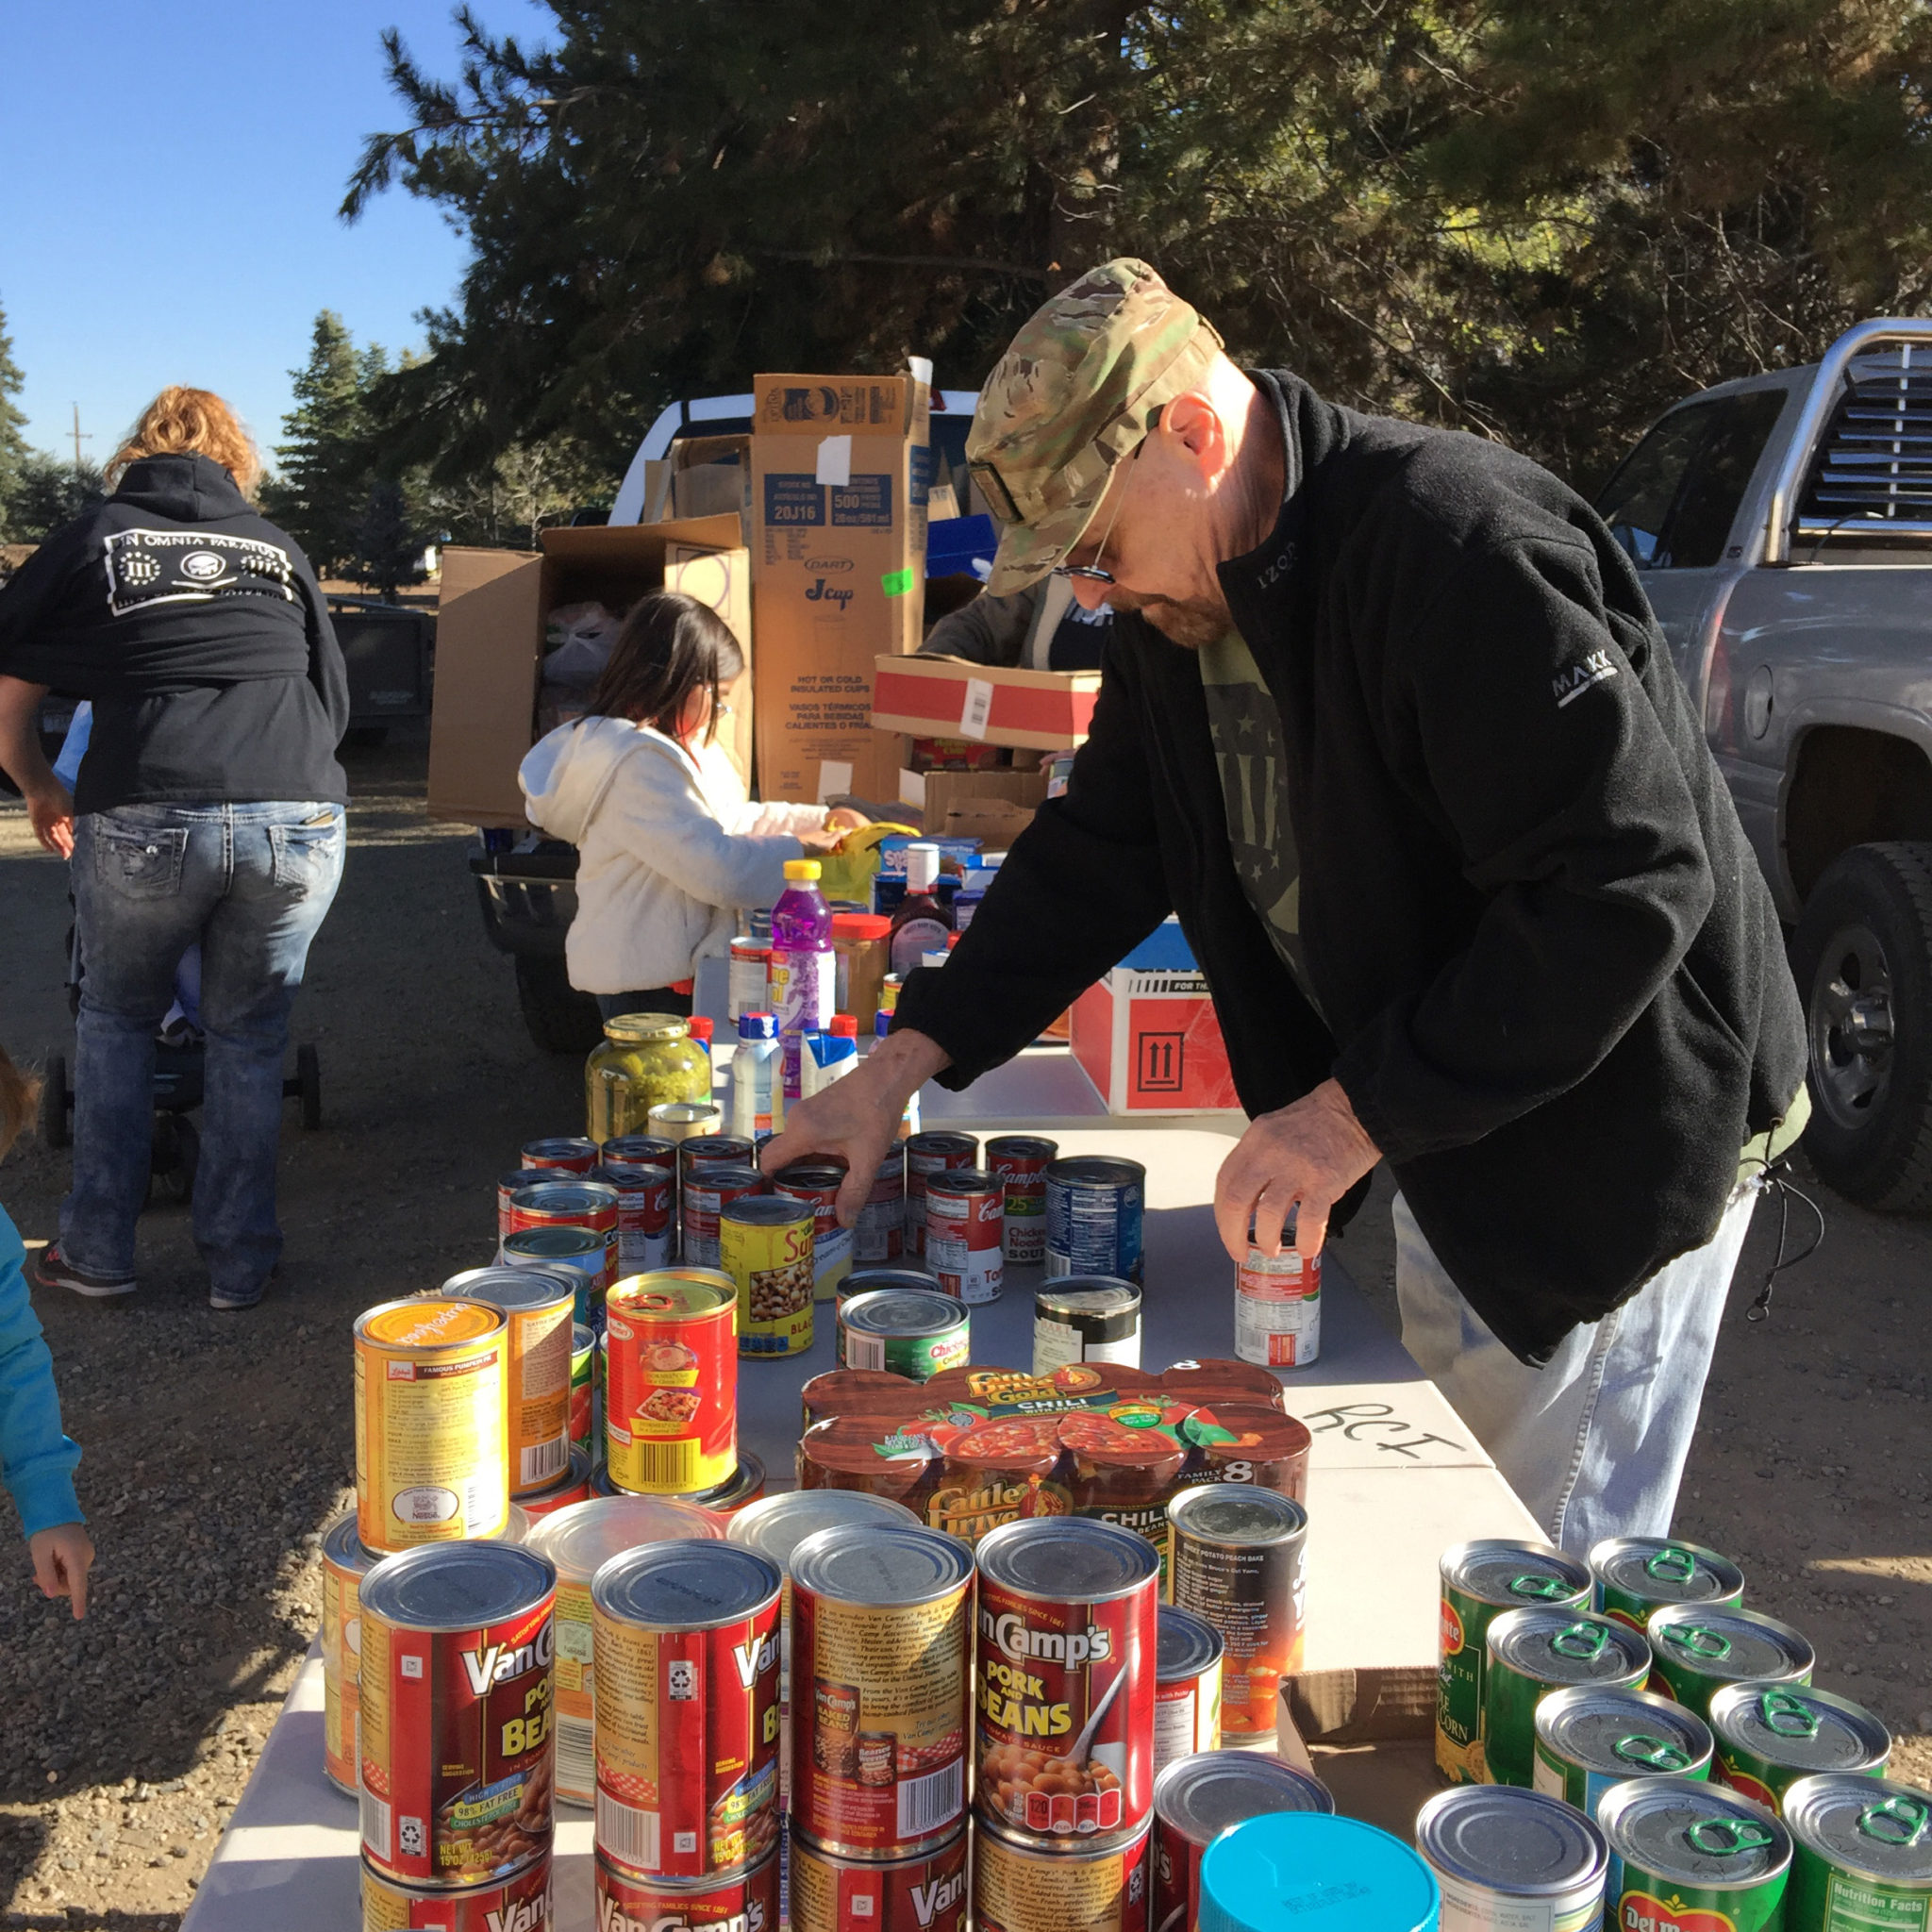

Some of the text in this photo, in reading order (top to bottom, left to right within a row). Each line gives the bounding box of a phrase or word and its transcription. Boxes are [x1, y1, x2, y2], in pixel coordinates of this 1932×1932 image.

[835, 494, 859, 508] 500
[774, 506, 815, 520] 20J16
[144, 535, 203, 546] OMNIA
[127, 561, 151, 576] III
[811, 560, 847, 569] DART
[791, 685, 870, 693] INSULATED CUPS
[425, 1365, 453, 1374] FAMOUS
[455, 1358, 483, 1371] PUMPKIN
[993, 1387, 1060, 1404] Gold
[1017, 1397, 1087, 1410] CHILI
[1178, 1470, 1221, 1480] FAMILY
[1223, 1461, 1253, 1483] 8
[1191, 1475, 1223, 1485] PACK
[927, 1481, 1021, 1507] Cattle
[1201, 1549, 1224, 1560] POTATO
[1027, 1607, 1048, 1622] SINCE
[858, 1630, 879, 1639] Camp
[996, 1612, 1110, 1671] Camp's
[733, 1631, 780, 1689] Van
[869, 1653, 902, 1661] premium
[461, 1644, 534, 1697] Van
[861, 1675, 882, 1684] brand
[987, 1660, 1044, 1701] PORK
[882, 1686, 893, 1694] the
[909, 1684, 928, 1693] Camp
[1001, 1687, 1024, 1701] AND
[827, 1694, 856, 1712] Camp's
[976, 1670, 1073, 1736] BEANS
[818, 1706, 850, 1722] BAKED
[819, 1714, 850, 1732] BEANS
[1440, 1707, 1469, 1741] CORN
[1024, 1740, 1061, 1755] SAUCE
[509, 1763, 521, 1772] IN
[468, 1788, 489, 1802] HIGH
[458, 1789, 519, 1817] 98% FAT FREE
[1030, 1798, 1048, 1814] 120
[440, 1844, 458, 1856] NET
[714, 1840, 729, 1853] NET
[440, 1856, 450, 1866] 15
[452, 1856, 465, 1866] OZ
[909, 1871, 963, 1927] Van
[1834, 1883, 1923, 1912] Nutrition Facts
[485, 1894, 546, 1932] Van
[598, 1888, 645, 1932] Van
[658, 1902, 689, 1910] FAMILIES
[691, 1904, 709, 1913] SINCE
[712, 1906, 728, 1915] 1861
[1626, 1905, 1656, 1932] Del
